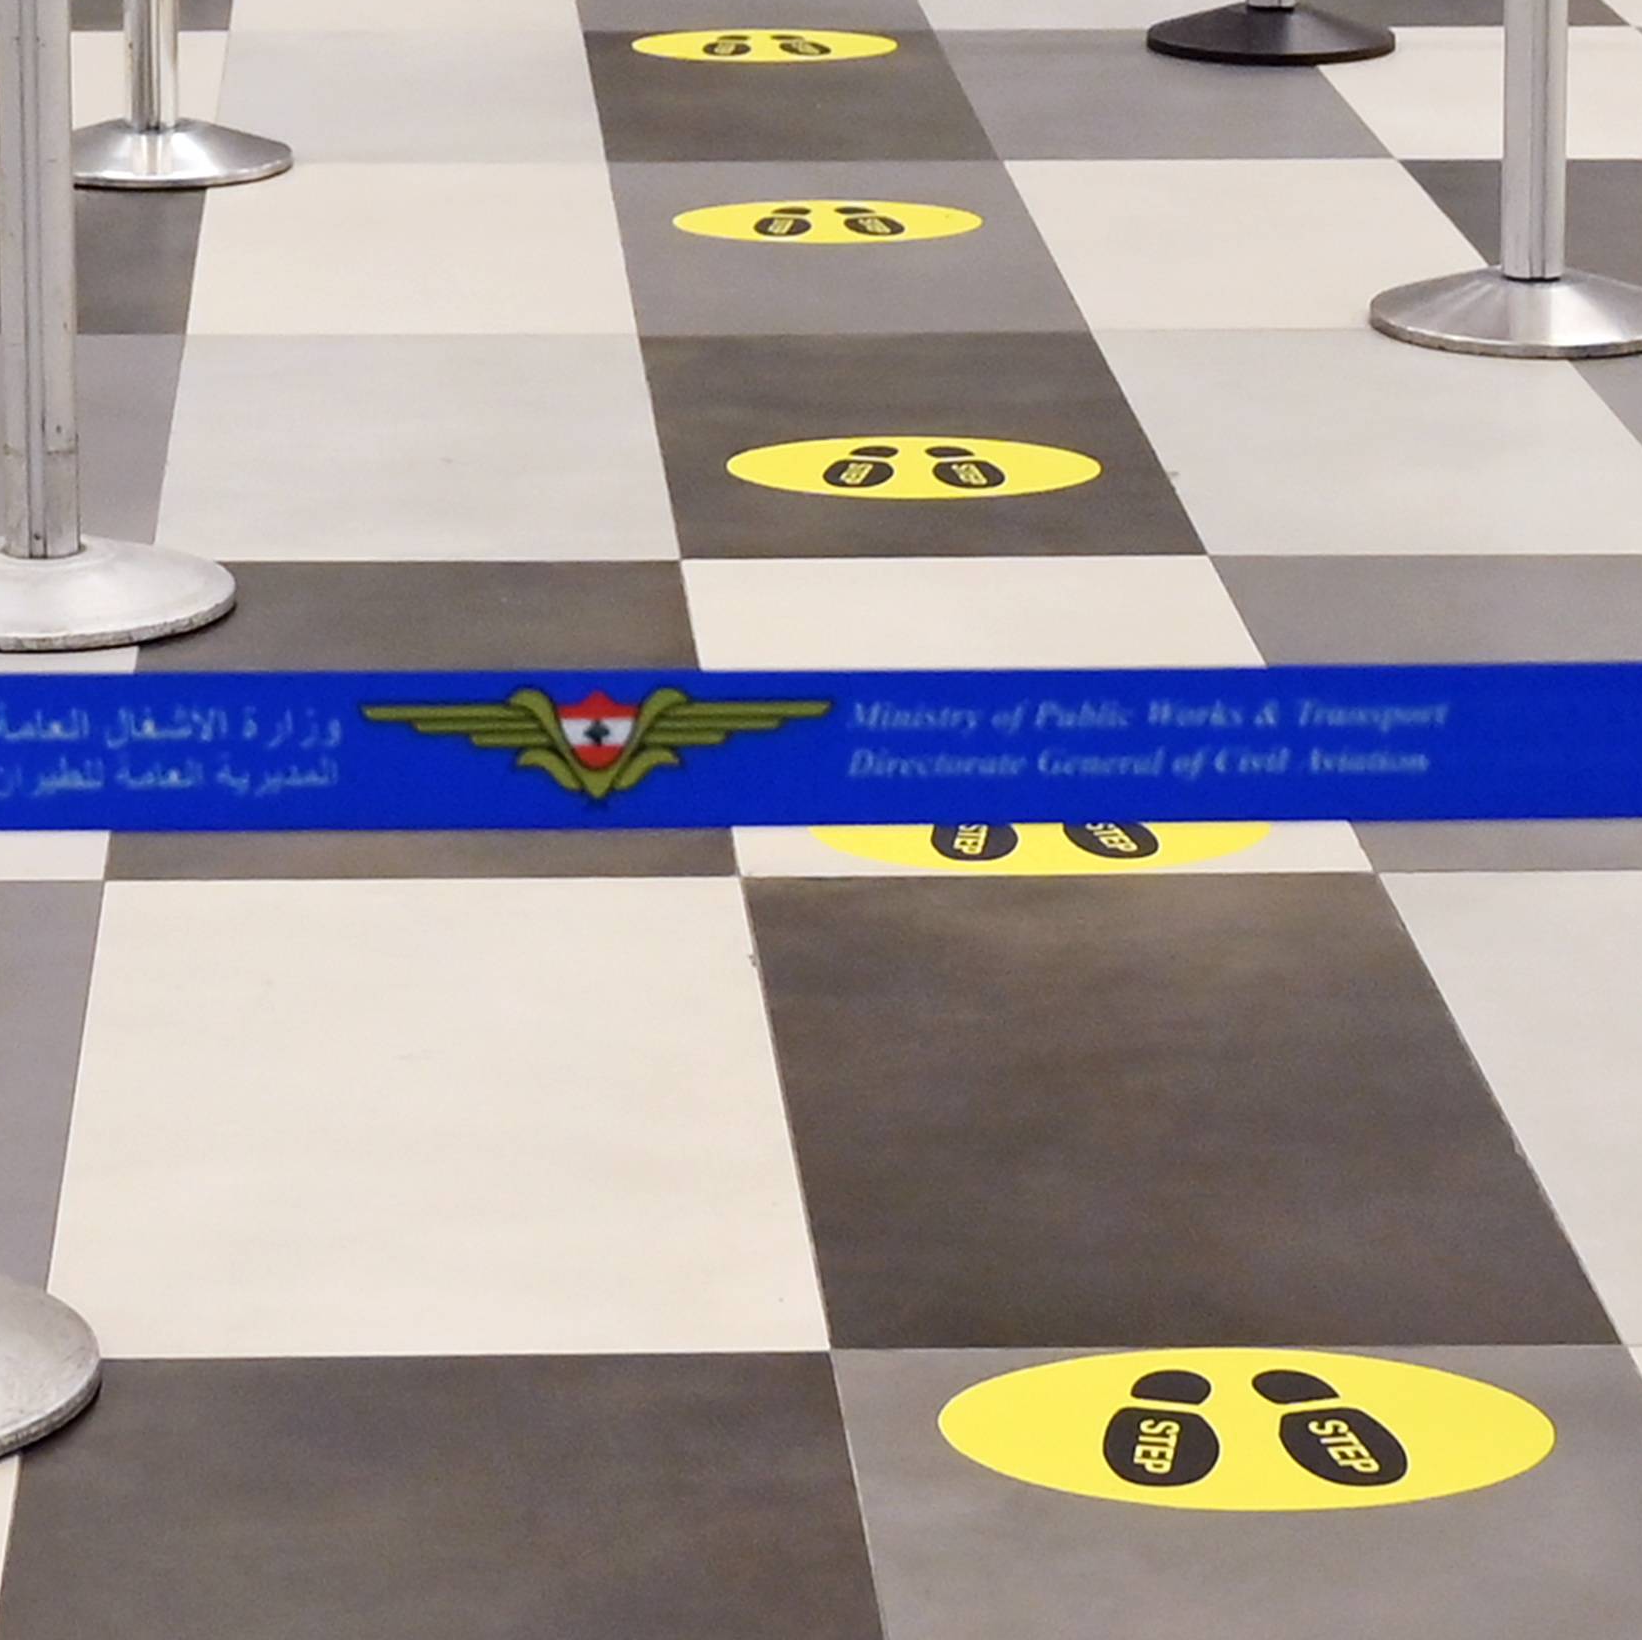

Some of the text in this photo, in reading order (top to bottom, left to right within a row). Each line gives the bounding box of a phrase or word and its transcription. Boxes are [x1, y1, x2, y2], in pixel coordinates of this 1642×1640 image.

[244, 702, 342, 750] وزارة
[851, 701, 979, 739] Ministry
[991, 700, 1025, 735] of
[1035, 701, 1133, 728] Public
[1147, 700, 1245, 728] Works
[1294, 699, 1450, 734] Transport
[846, 747, 1026, 779] Directorate
[1037, 746, 1165, 778] General
[1170, 746, 1210, 782] of
[1131, 1418, 1181, 1476] STEP
[1307, 1418, 1382, 1477] STEP
